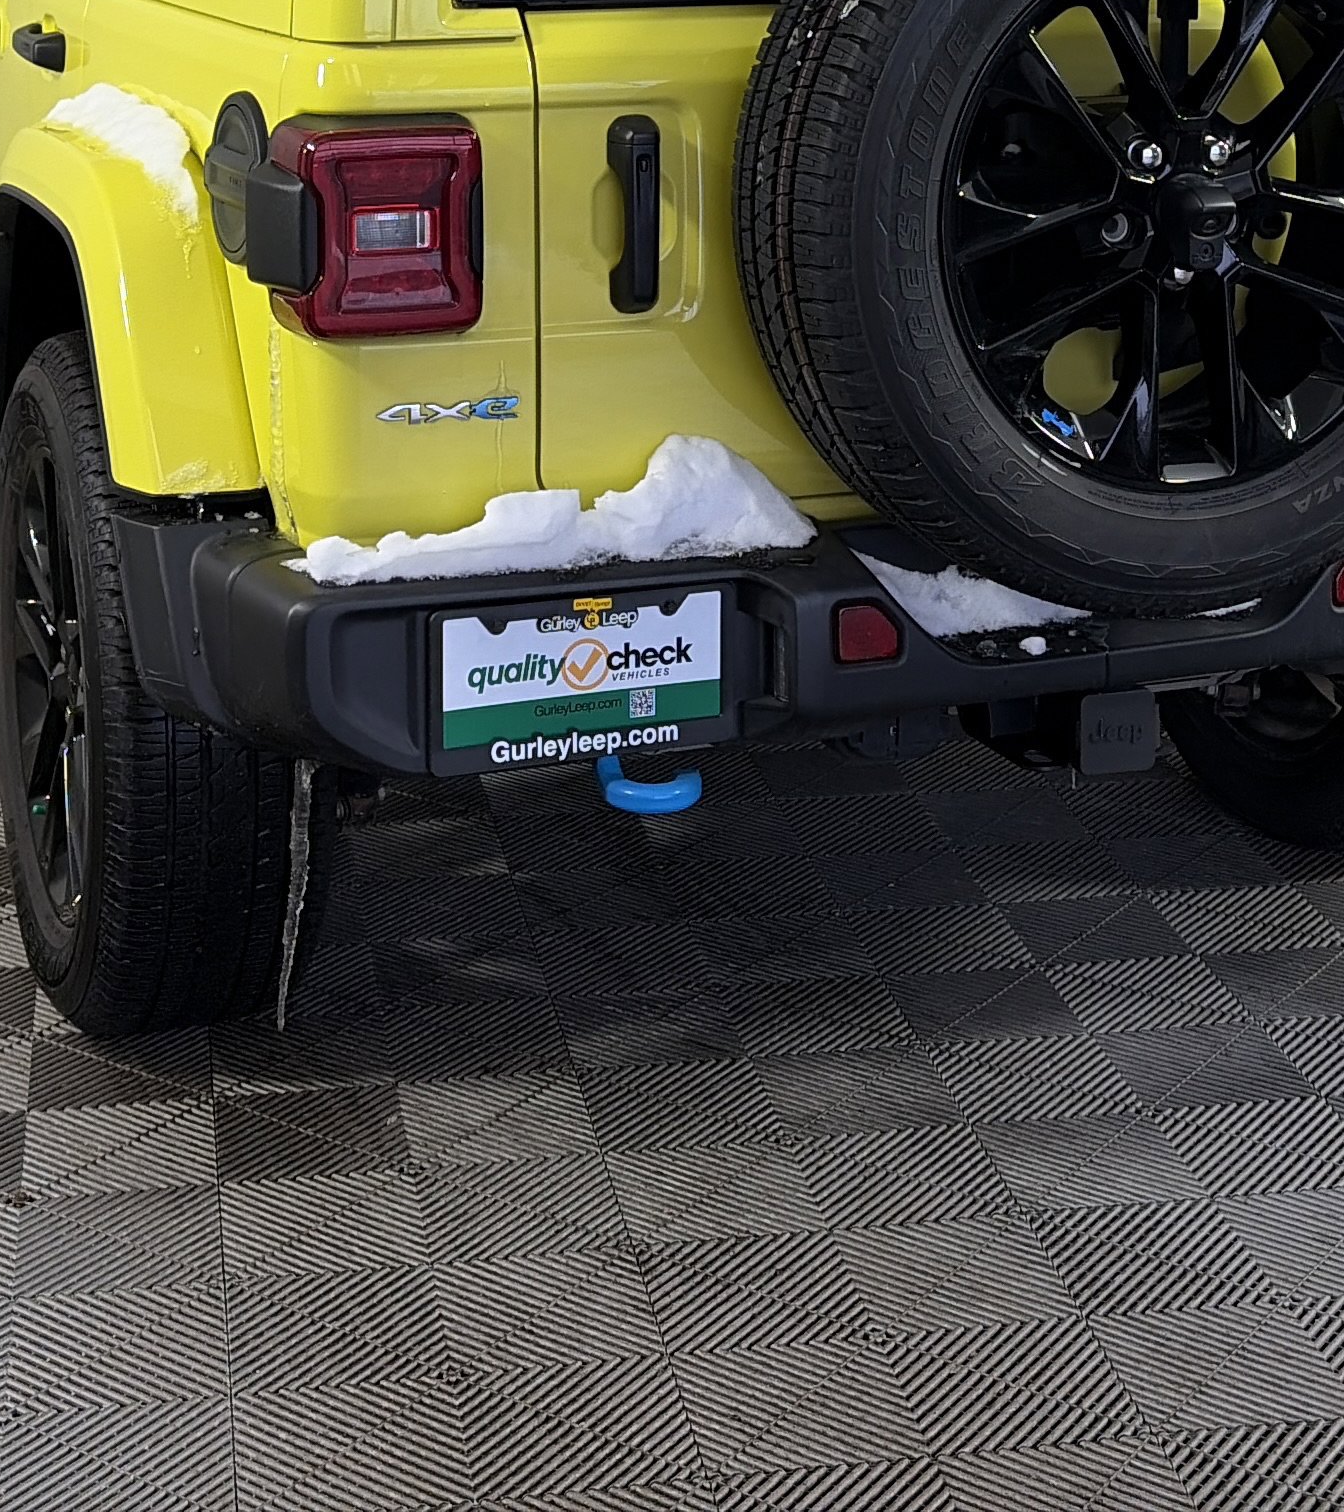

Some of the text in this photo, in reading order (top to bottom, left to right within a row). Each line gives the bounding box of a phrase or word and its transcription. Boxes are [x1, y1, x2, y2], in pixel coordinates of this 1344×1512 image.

[896, 20, 1044, 504] BRIDGESTONE
[540, 615, 582, 632] Gurley
[602, 611, 637, 627] Leep
[467, 637, 693, 694] quality check
[612, 667, 670, 682] VEHICLES
[534, 698, 622, 717] GurleyLeep.com
[490, 723, 679, 764] Gurleyleep.com
[1088, 717, 1143, 745] Jeep
